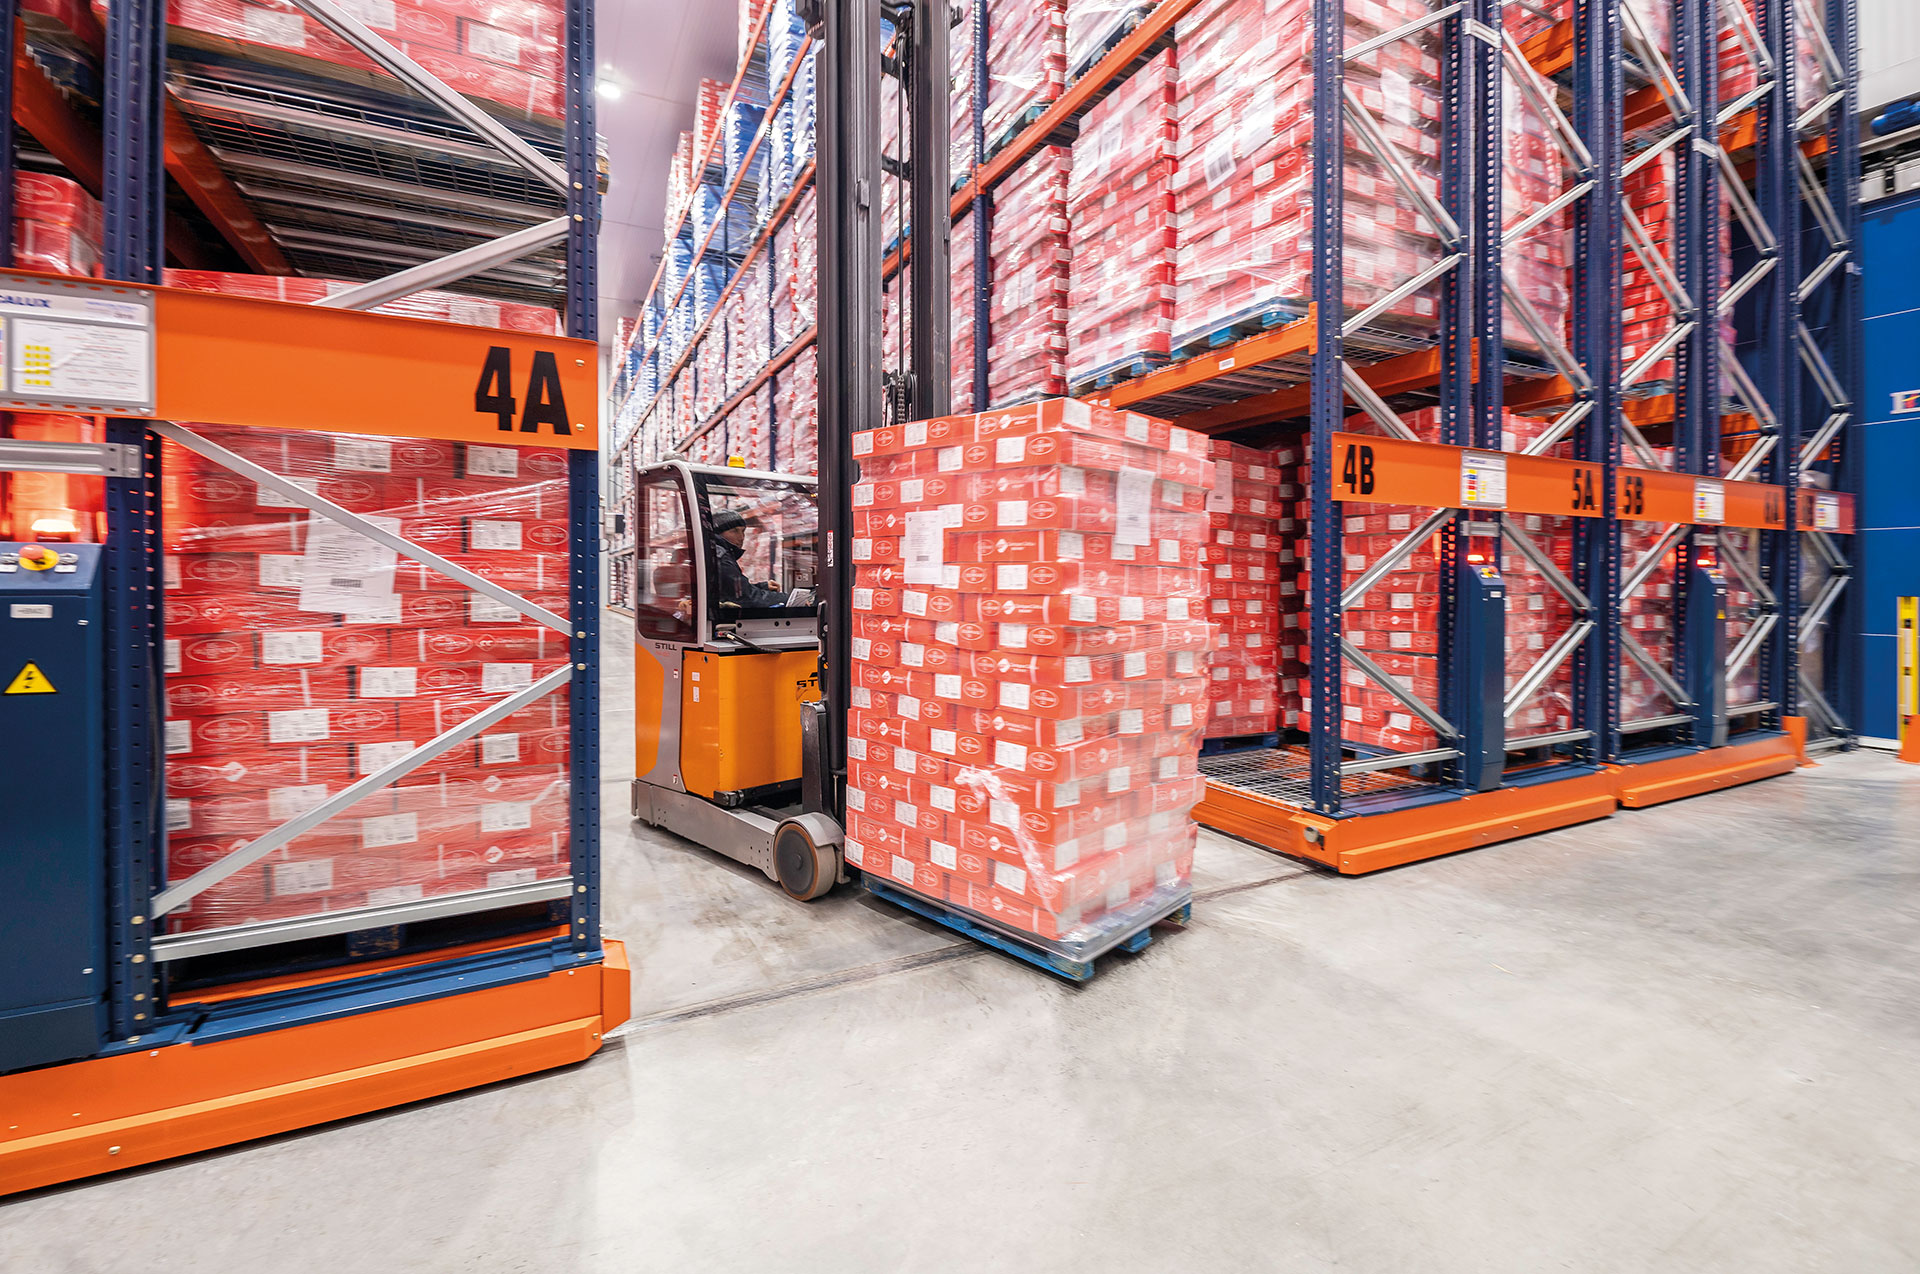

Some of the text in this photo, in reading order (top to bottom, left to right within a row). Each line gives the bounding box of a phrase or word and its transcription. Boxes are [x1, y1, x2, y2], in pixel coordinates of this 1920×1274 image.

[0, 294, 51, 309] ALUX
[475, 346, 572, 436] 4A
[1343, 444, 1374, 495] 4B
[1573, 469, 1595, 511] 5A
[1624, 476, 1643, 515] 5B
[655, 642, 677, 651] STILL
